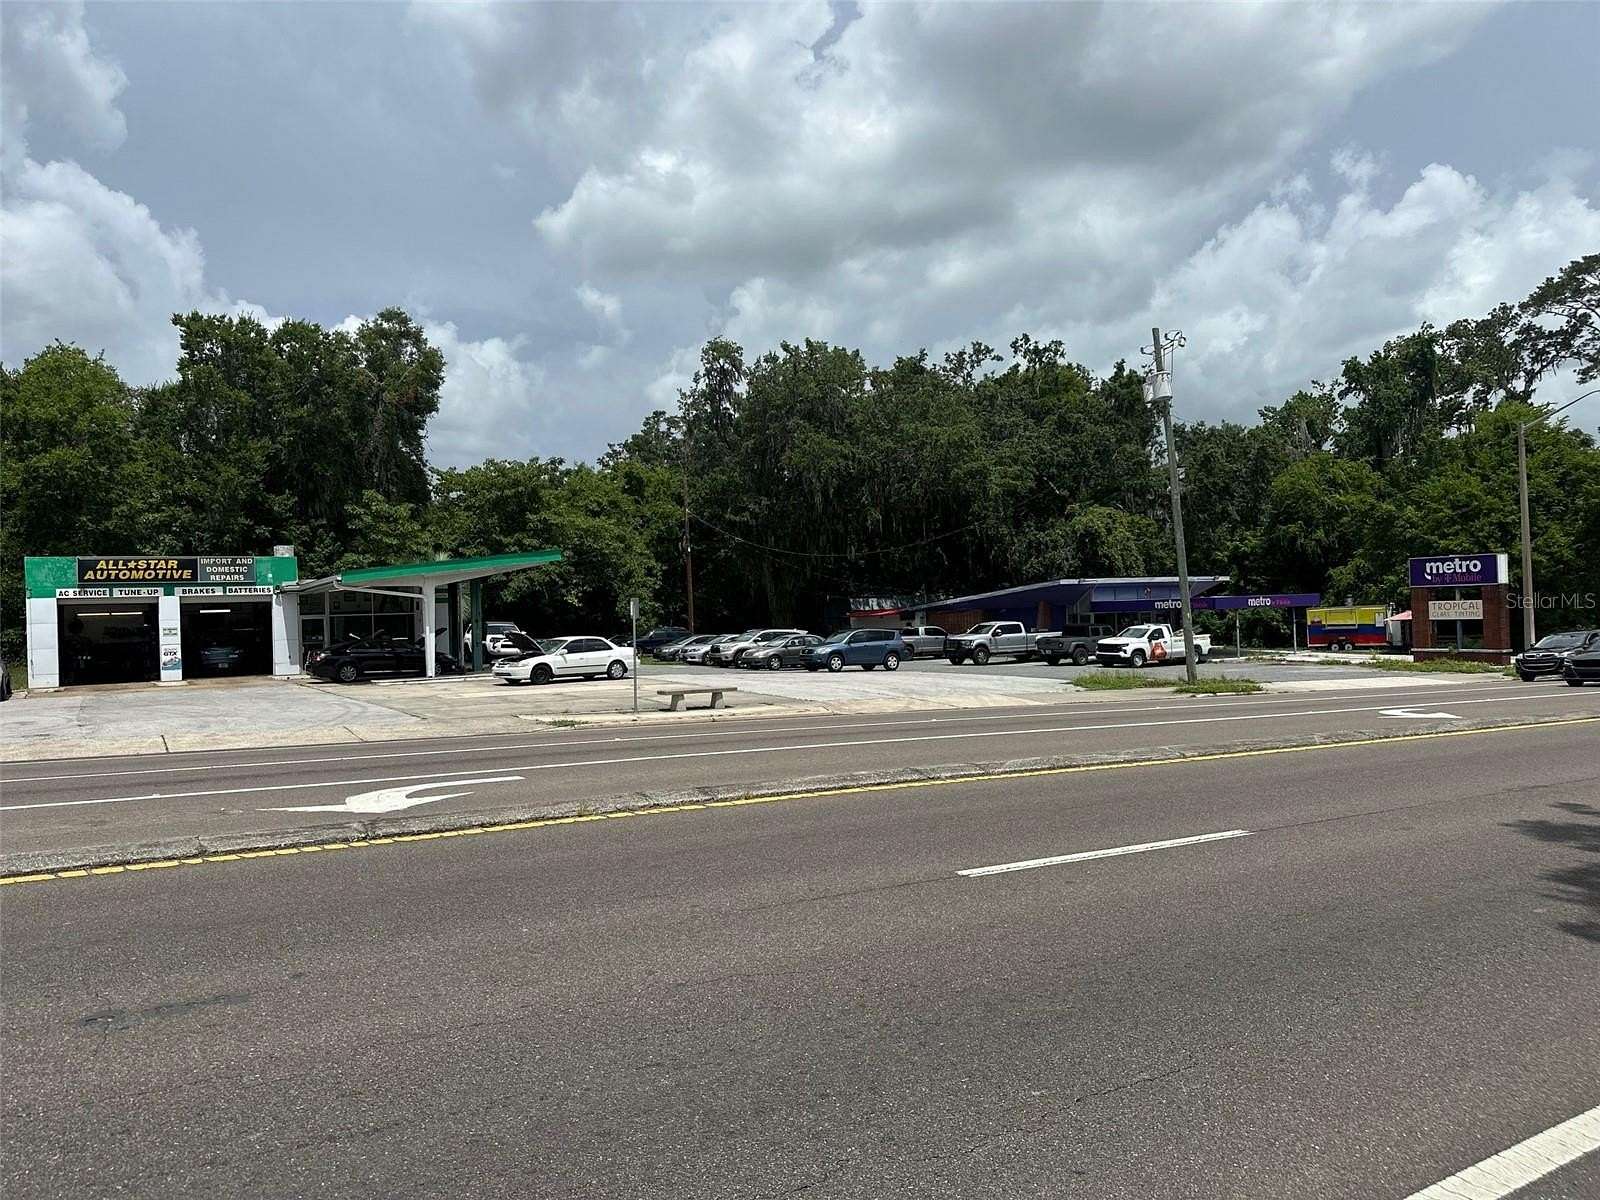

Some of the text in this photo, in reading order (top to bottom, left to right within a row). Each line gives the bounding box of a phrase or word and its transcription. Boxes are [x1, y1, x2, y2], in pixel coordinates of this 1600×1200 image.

[1425, 558, 1482, 574] metro
[84, 570, 192, 580] AUTOMOTIVE
[1154, 600, 1182, 608] metro
[1248, 596, 1271, 606] metro
[1432, 602, 1481, 610] TROPICAL
